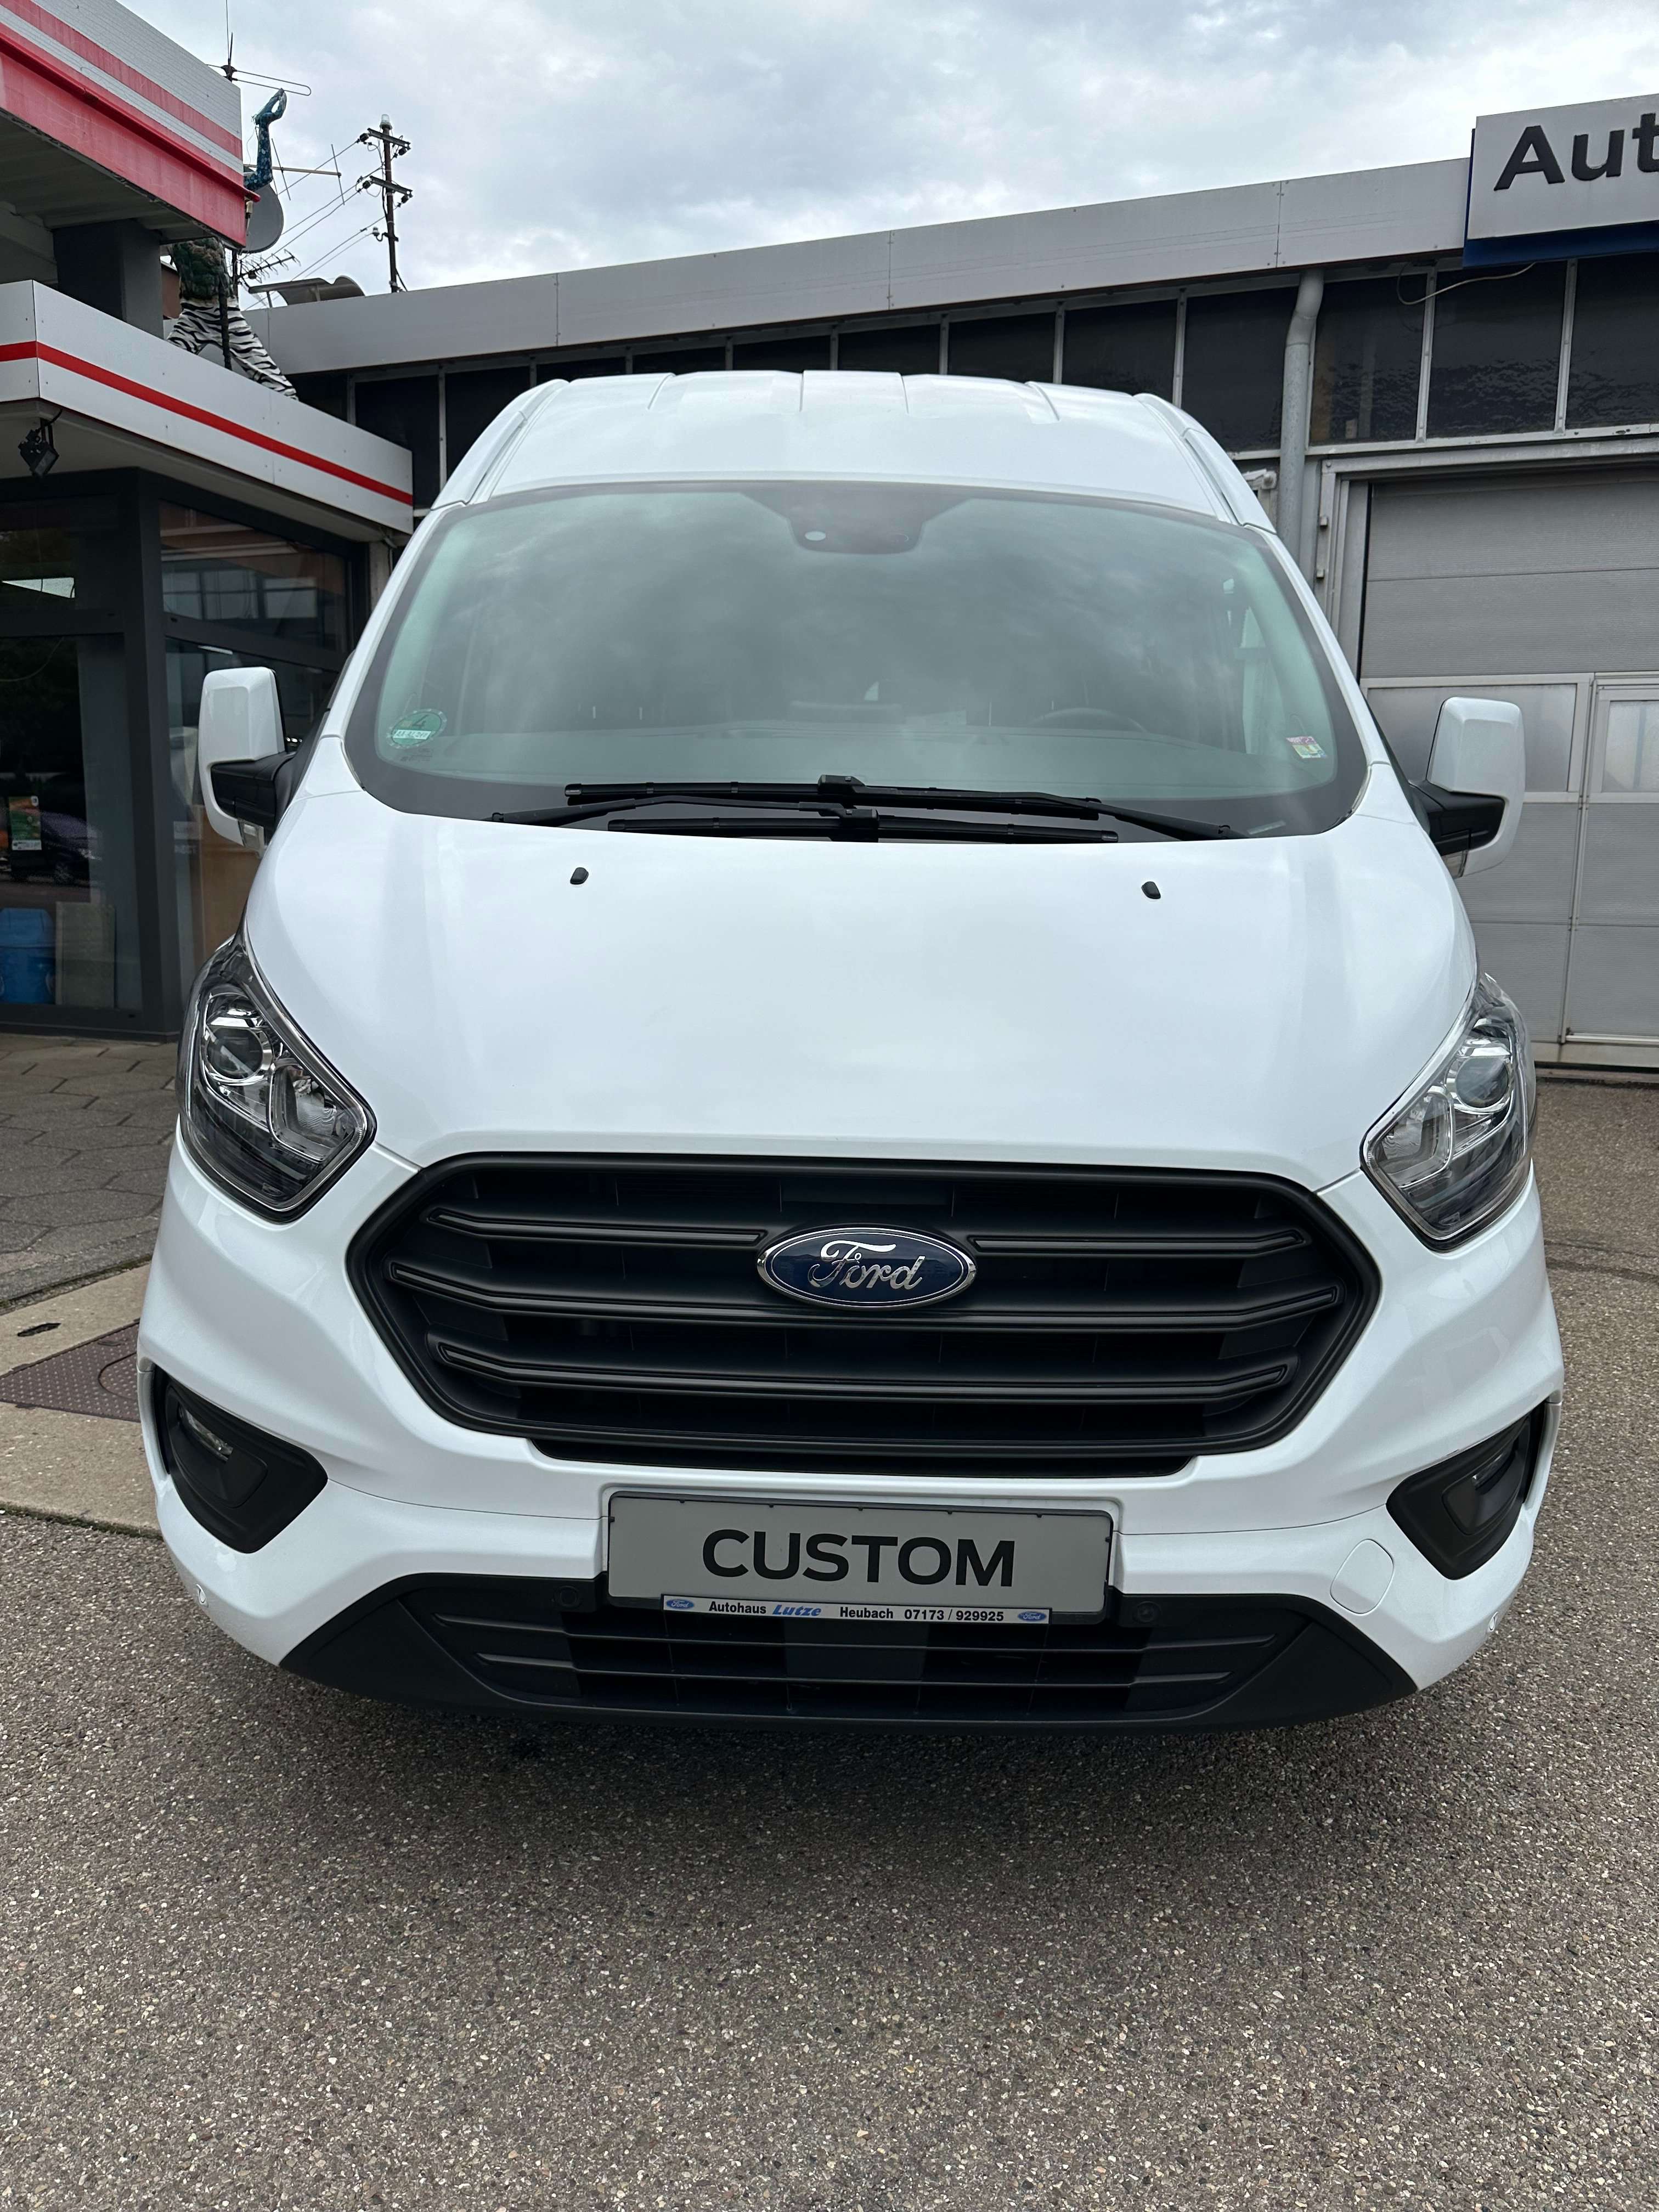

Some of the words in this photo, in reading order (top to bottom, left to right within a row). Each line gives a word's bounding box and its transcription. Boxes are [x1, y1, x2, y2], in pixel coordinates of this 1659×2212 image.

[413, 715, 427, 729] 4
[808, 1240, 925, 1289] Ford
[702, 1529, 1015, 1587] CUSTOM
[709, 1601, 766, 1614] Autohaus
[772, 1605, 821, 1616] Lutze
[839, 1606, 893, 1619] Heubach
[904, 1609, 944, 1620] 07173
[956, 1610, 1004, 1621] 929925
